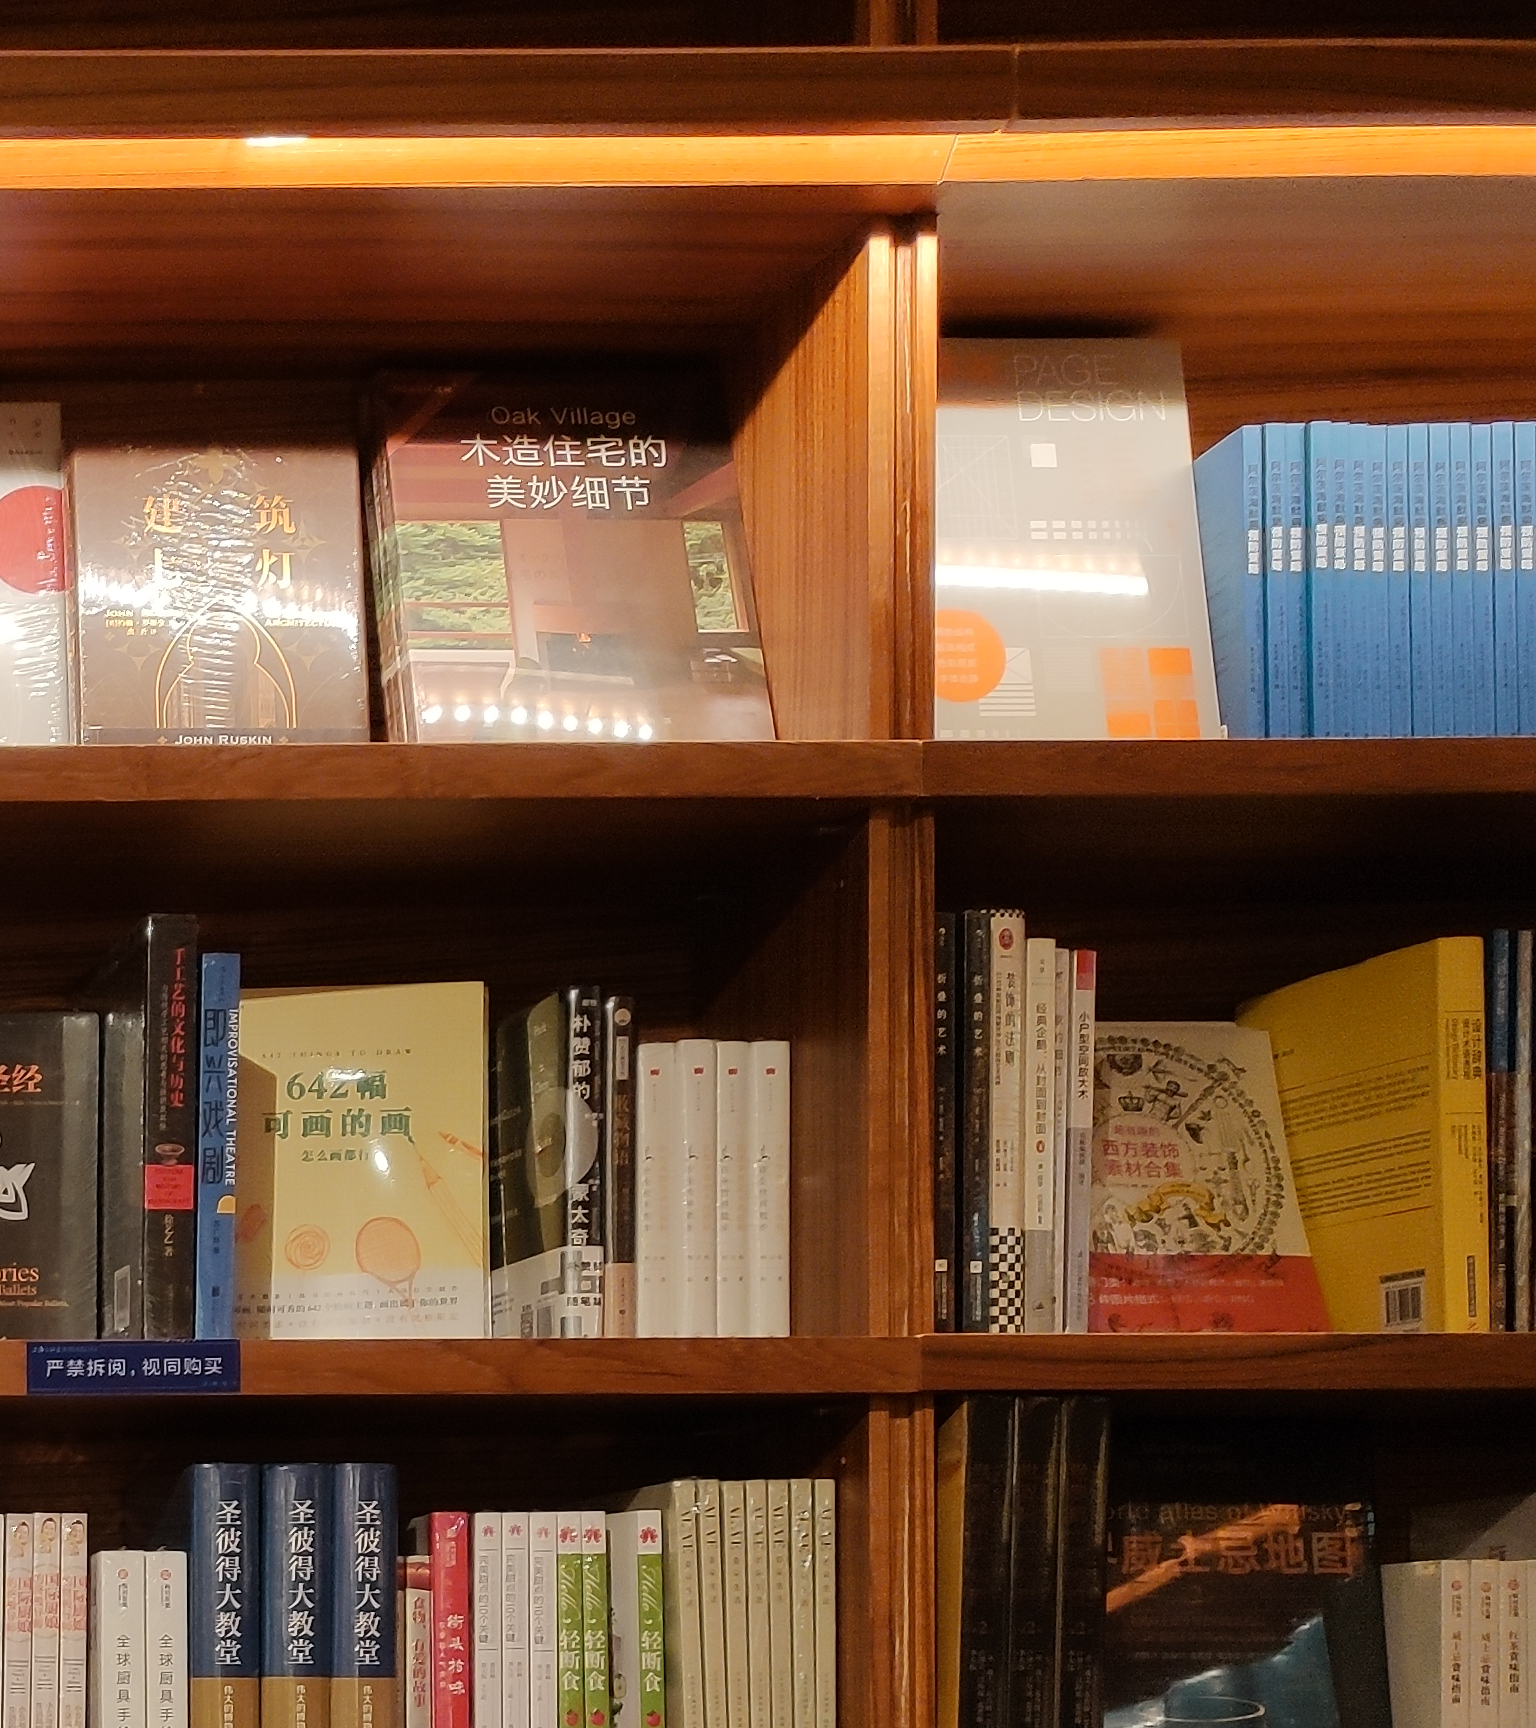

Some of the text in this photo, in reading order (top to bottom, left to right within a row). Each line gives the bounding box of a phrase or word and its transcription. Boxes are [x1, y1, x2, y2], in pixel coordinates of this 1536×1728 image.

[490, 404, 637, 428] Oak Village
[1018, 391, 1166, 422] DESIGN
[459, 433, 667, 468] 木造住宅的
[486, 474, 652, 511] 美妙细节
[254, 494, 296, 533] 筑
[254, 549, 293, 589] 灯
[169, 947, 187, 1108] 手工艺的文化与历史
[203, 1008, 226, 1186] 即兴戏剧
[225, 1009, 241, 1186] IMPROVISATIONAL THEATRE
[263, 1107, 413, 1140] 可画的画
[1102, 1140, 1180, 1161] 西方装饰
[1102, 1159, 1184, 1180] 素材合集
[45, 1358, 223, 1378] 严禁拆阅，视同购买
[214, 1500, 242, 1667] 圣彼得大教堂
[287, 1500, 316, 1667] 圣彼得大教堂
[353, 1500, 382, 1667] 圣彼得大教堂
[559, 1628, 582, 1694] 轻断食
[640, 1628, 664, 1694] 轻断食
